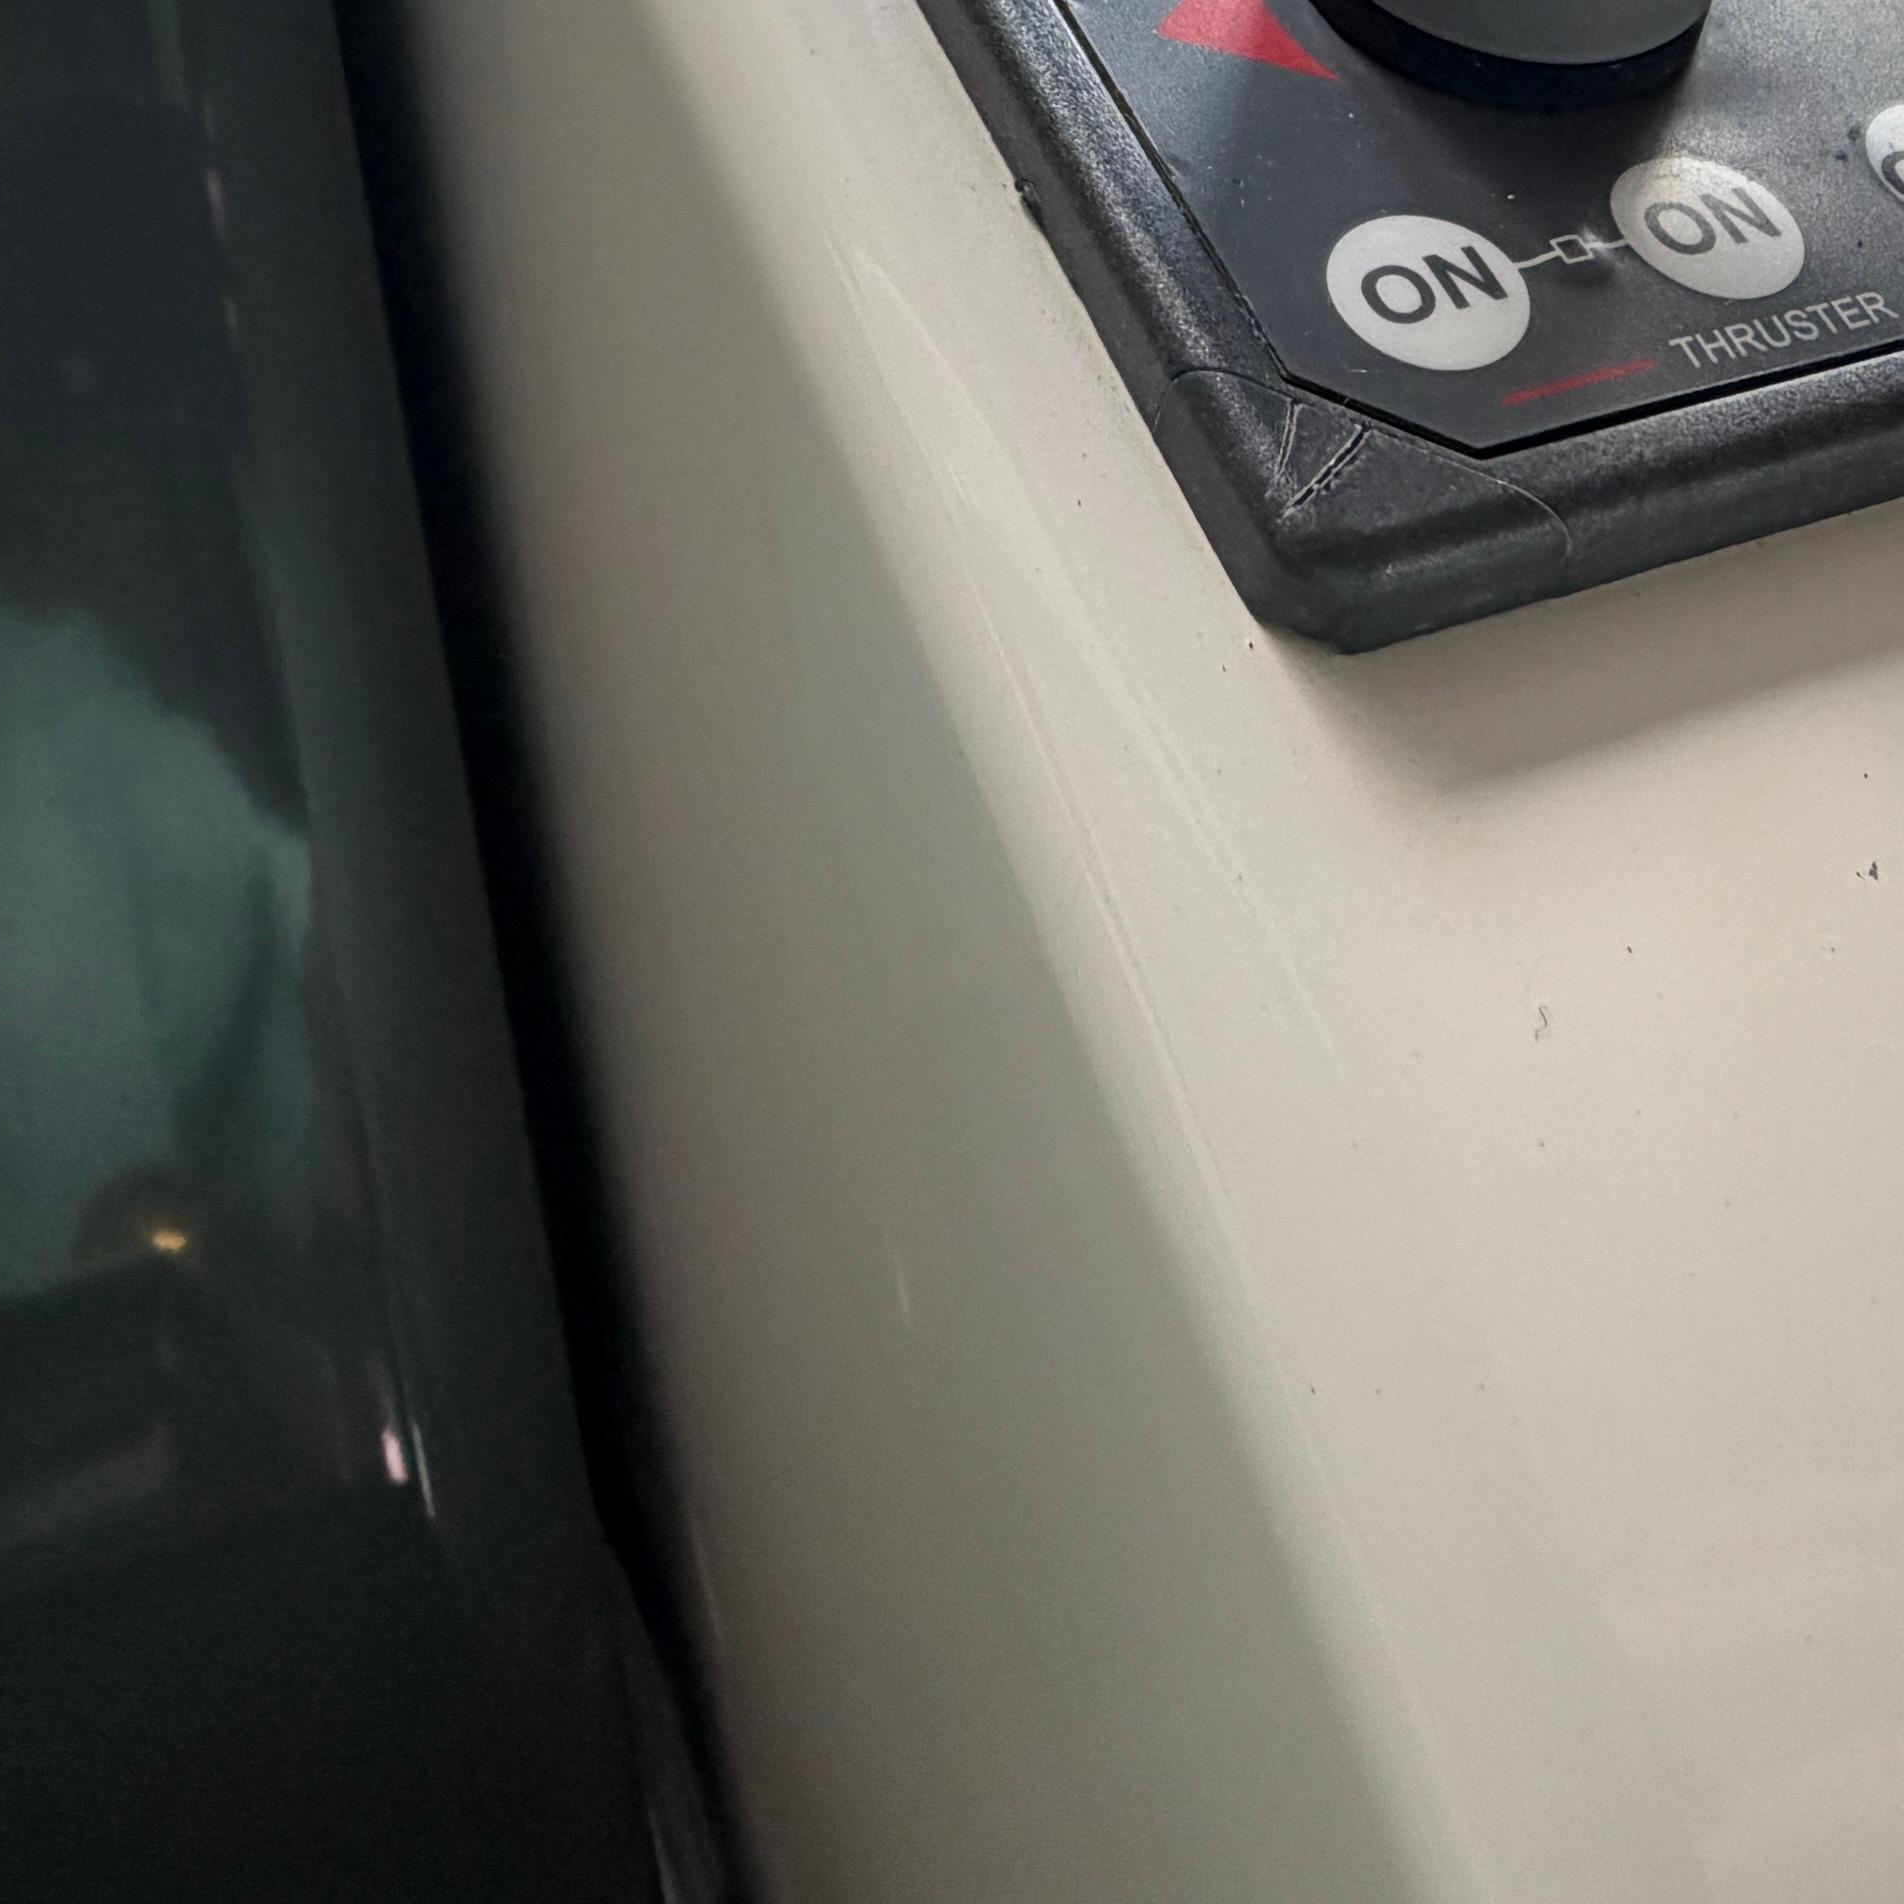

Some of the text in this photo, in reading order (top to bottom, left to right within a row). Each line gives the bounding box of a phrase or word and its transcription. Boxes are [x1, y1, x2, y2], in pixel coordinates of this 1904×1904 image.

[1643, 186, 1782, 256] ON
[1360, 244, 1509, 325] ON
[1668, 291, 1900, 370] THRUSTER
